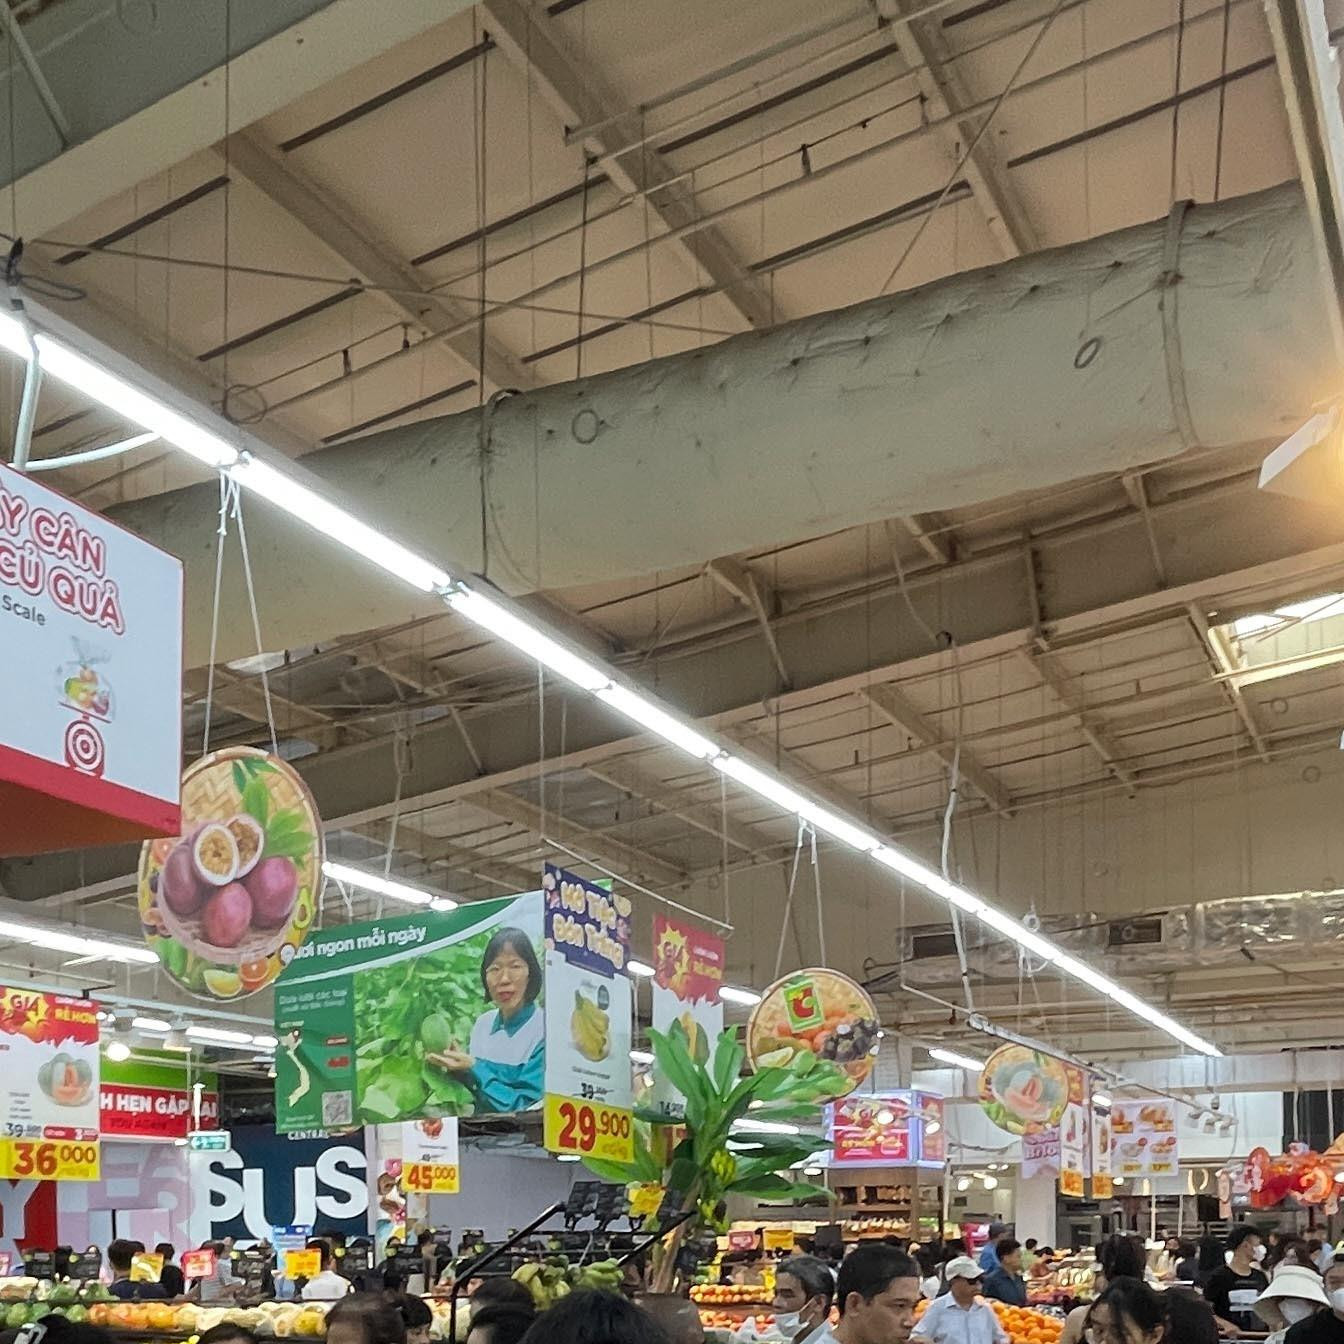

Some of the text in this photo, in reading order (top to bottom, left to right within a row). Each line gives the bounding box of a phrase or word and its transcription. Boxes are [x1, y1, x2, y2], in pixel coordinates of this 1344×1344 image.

[29, 508, 105, 577] CÂN
[2, 595, 46, 625] Scale
[48, 566, 125, 635] QUẢ
[317, 938, 355, 957] ngon
[388, 924, 427, 946] ngày
